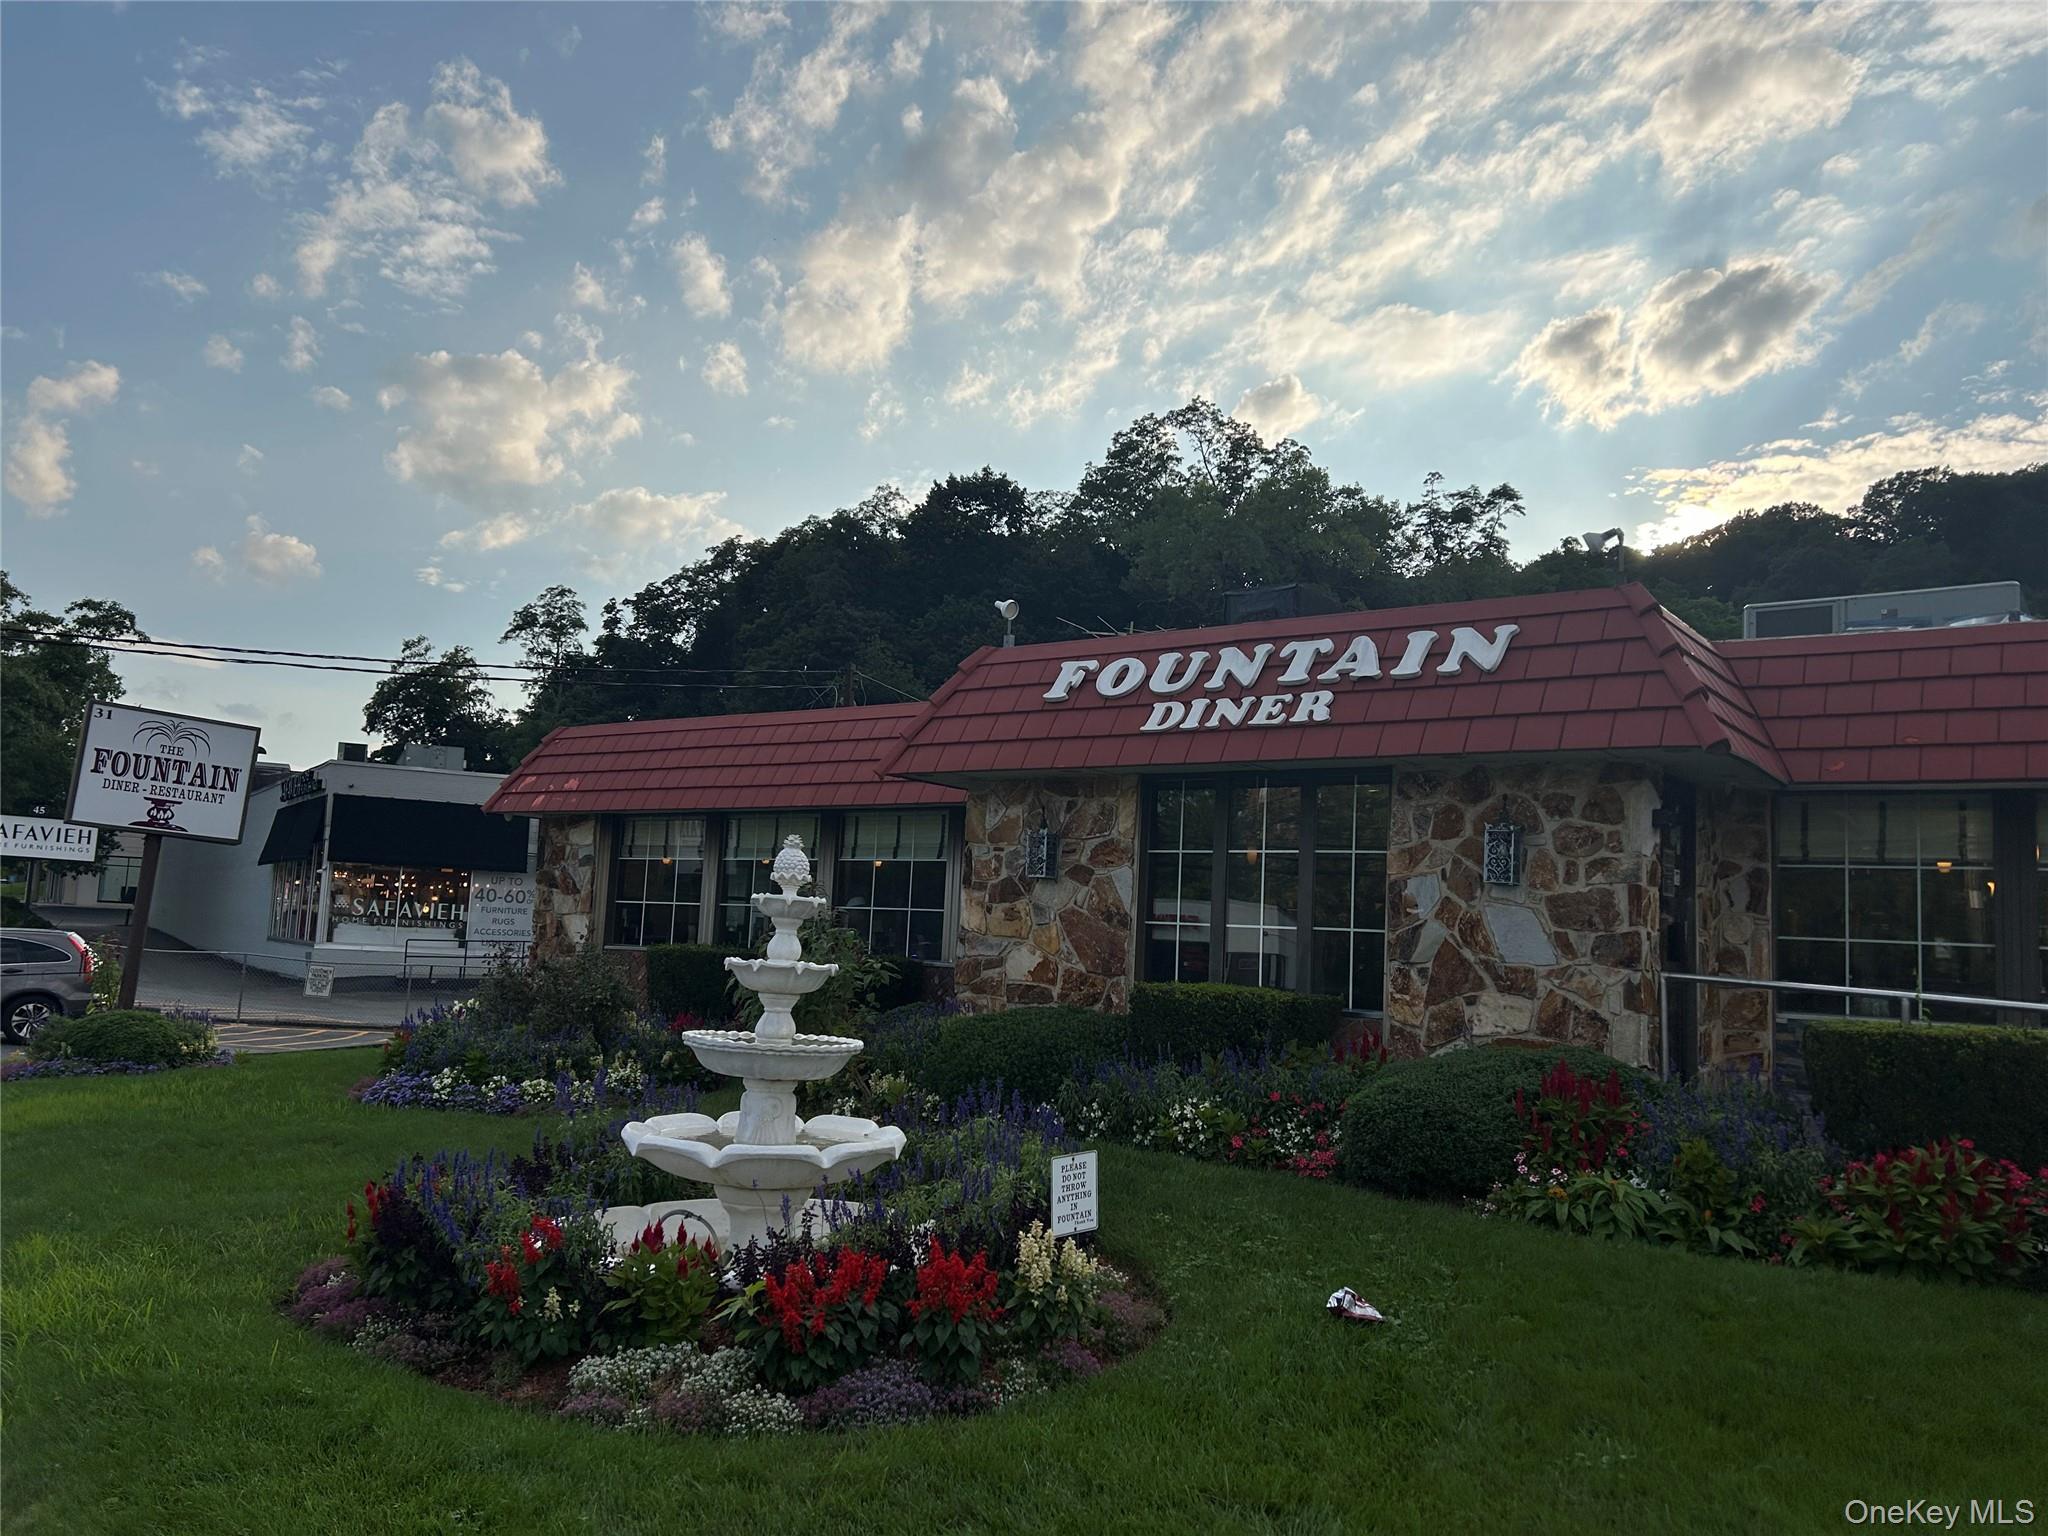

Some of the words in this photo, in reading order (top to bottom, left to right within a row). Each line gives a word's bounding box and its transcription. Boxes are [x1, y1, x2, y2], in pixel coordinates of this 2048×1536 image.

[1042, 624, 1520, 702] FOUNTAIN
[94, 707, 113, 720] 31
[1139, 690, 1335, 733] DINER
[160, 744, 185, 757] THE
[90, 747, 242, 793] FOUNTAIN
[102, 778, 140, 793] DINER
[149, 784, 225, 805] RESTAURANT
[32, 805, 47, 815] 45
[14, 842, 91, 854] FURNISHINGS
[490, 876, 506, 885] UP
[508, 877, 524, 886] TO
[352, 898, 465, 921] SAFAVIEH
[480, 906, 529, 915] FURNITURE
[332, 915, 369, 926] HOME
[373, 918, 463, 930] FURNISHINGS
[491, 917, 516, 926] RUGS
[473, 927, 532, 937] ACCESSORIES
[1061, 1161, 1087, 1174] PLEASE
[1062, 1174, 1072, 1183] DO
[1072, 1172, 1086, 1181] NOT
[1061, 1181, 1087, 1193] THROW
[1057, 1190, 1092, 1205] ANYTHING
[1070, 1202, 1078, 1211] IN
[1057, 1209, 1092, 1224] FOUNTAIN
